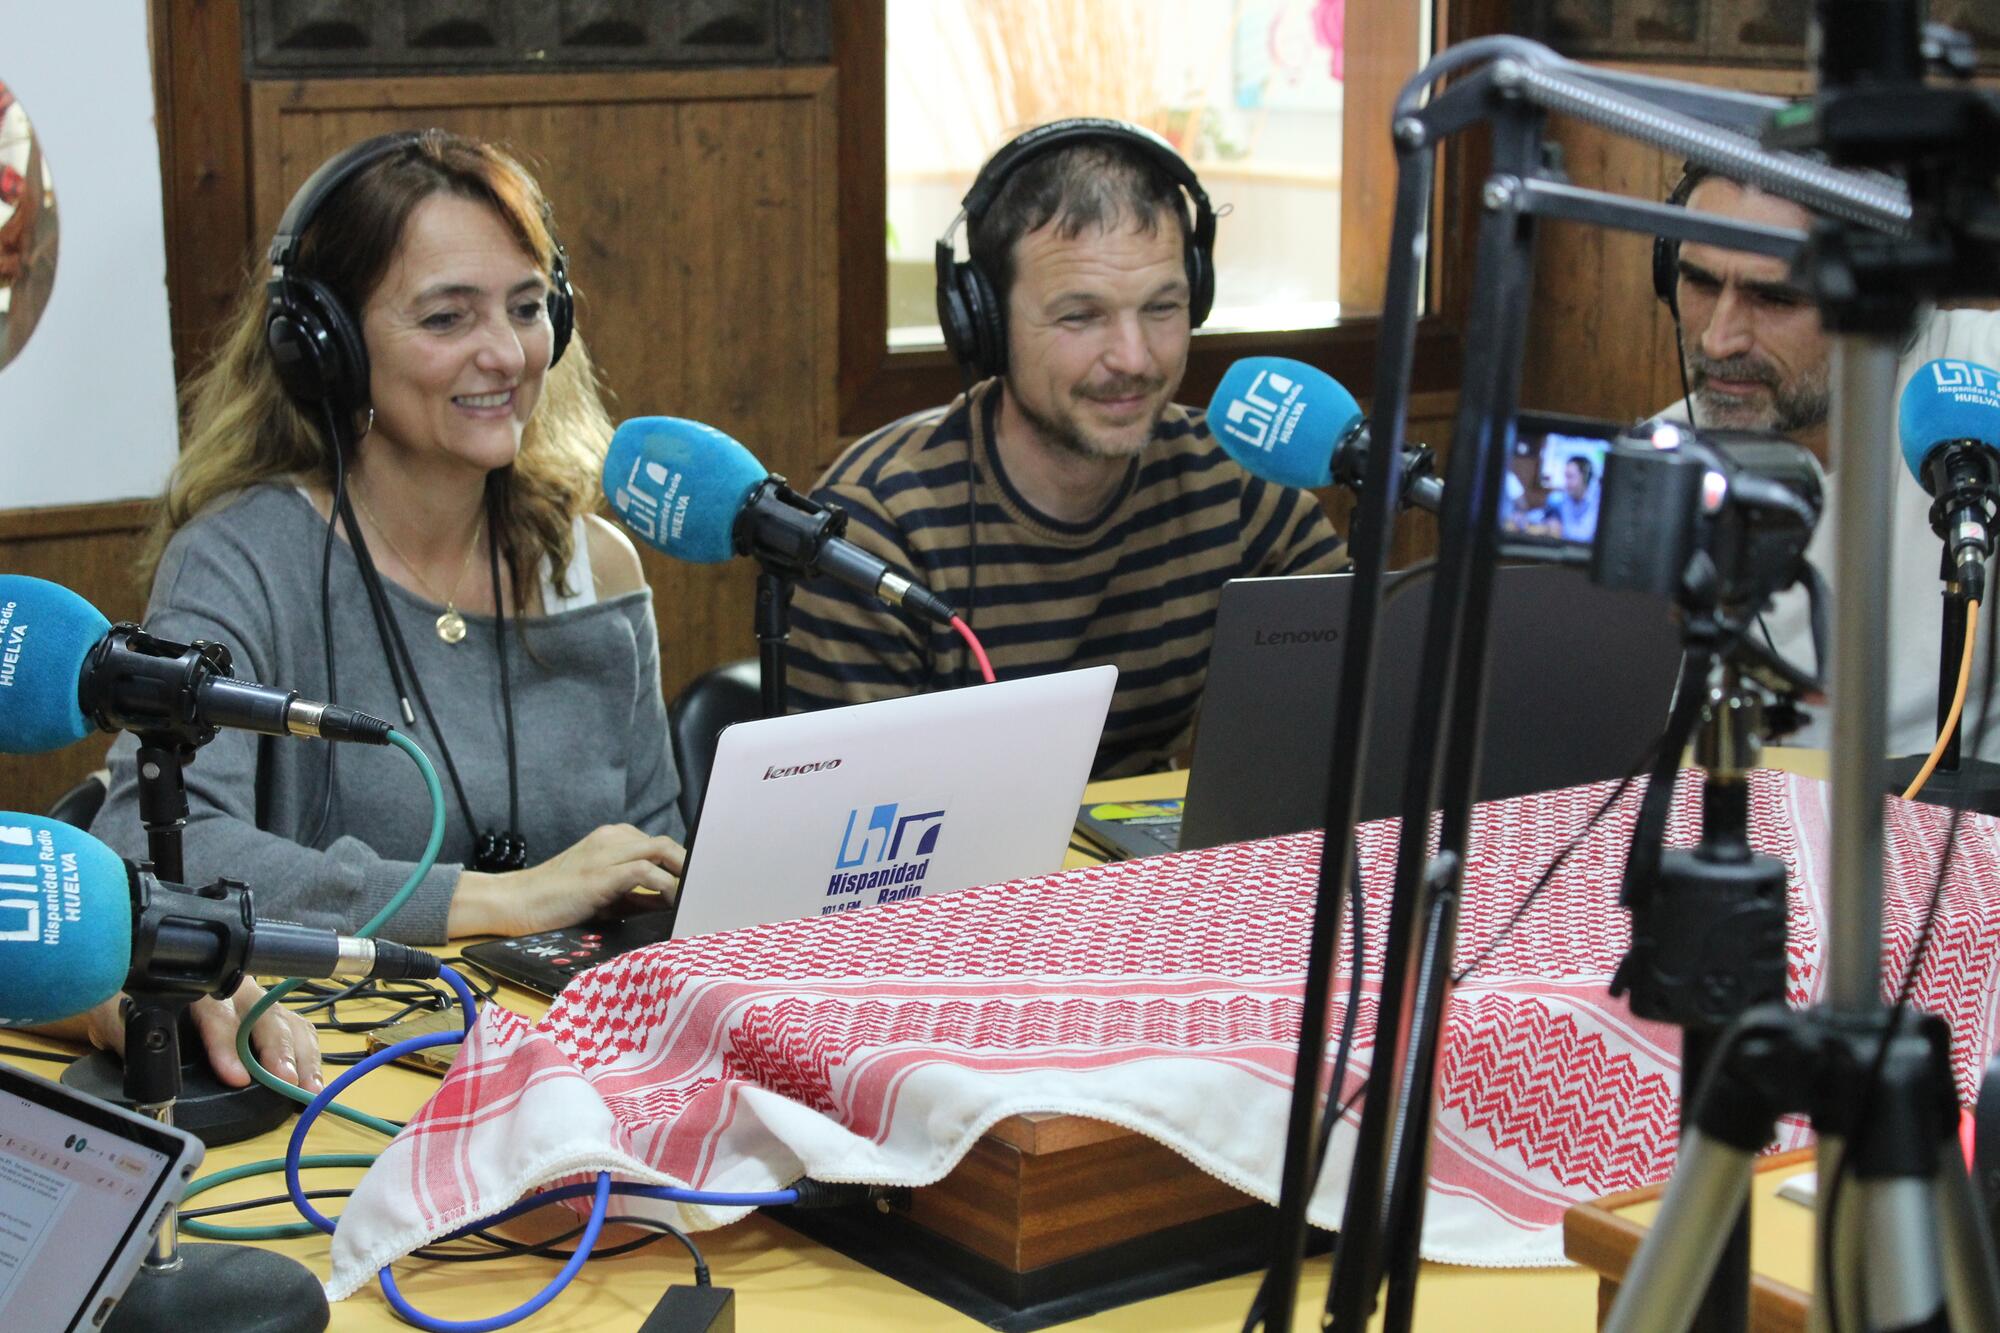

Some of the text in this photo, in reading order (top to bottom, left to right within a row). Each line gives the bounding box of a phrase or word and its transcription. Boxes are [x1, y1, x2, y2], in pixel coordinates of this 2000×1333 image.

[1954, 393, 2000, 408] HUELVA
[1280, 402, 1307, 444] HUELVA
[671, 495, 690, 539] HUELVA
[0, 624, 28, 687] HUELVA
[1254, 630, 1338, 645] Lenovo
[763, 758, 843, 781] lenovo
[37, 830, 63, 945] Hispanidad Radio
[61, 853, 81, 922] HUELVA
[826, 859, 930, 896] Hispanidad
[877, 884, 922, 905] Radio
